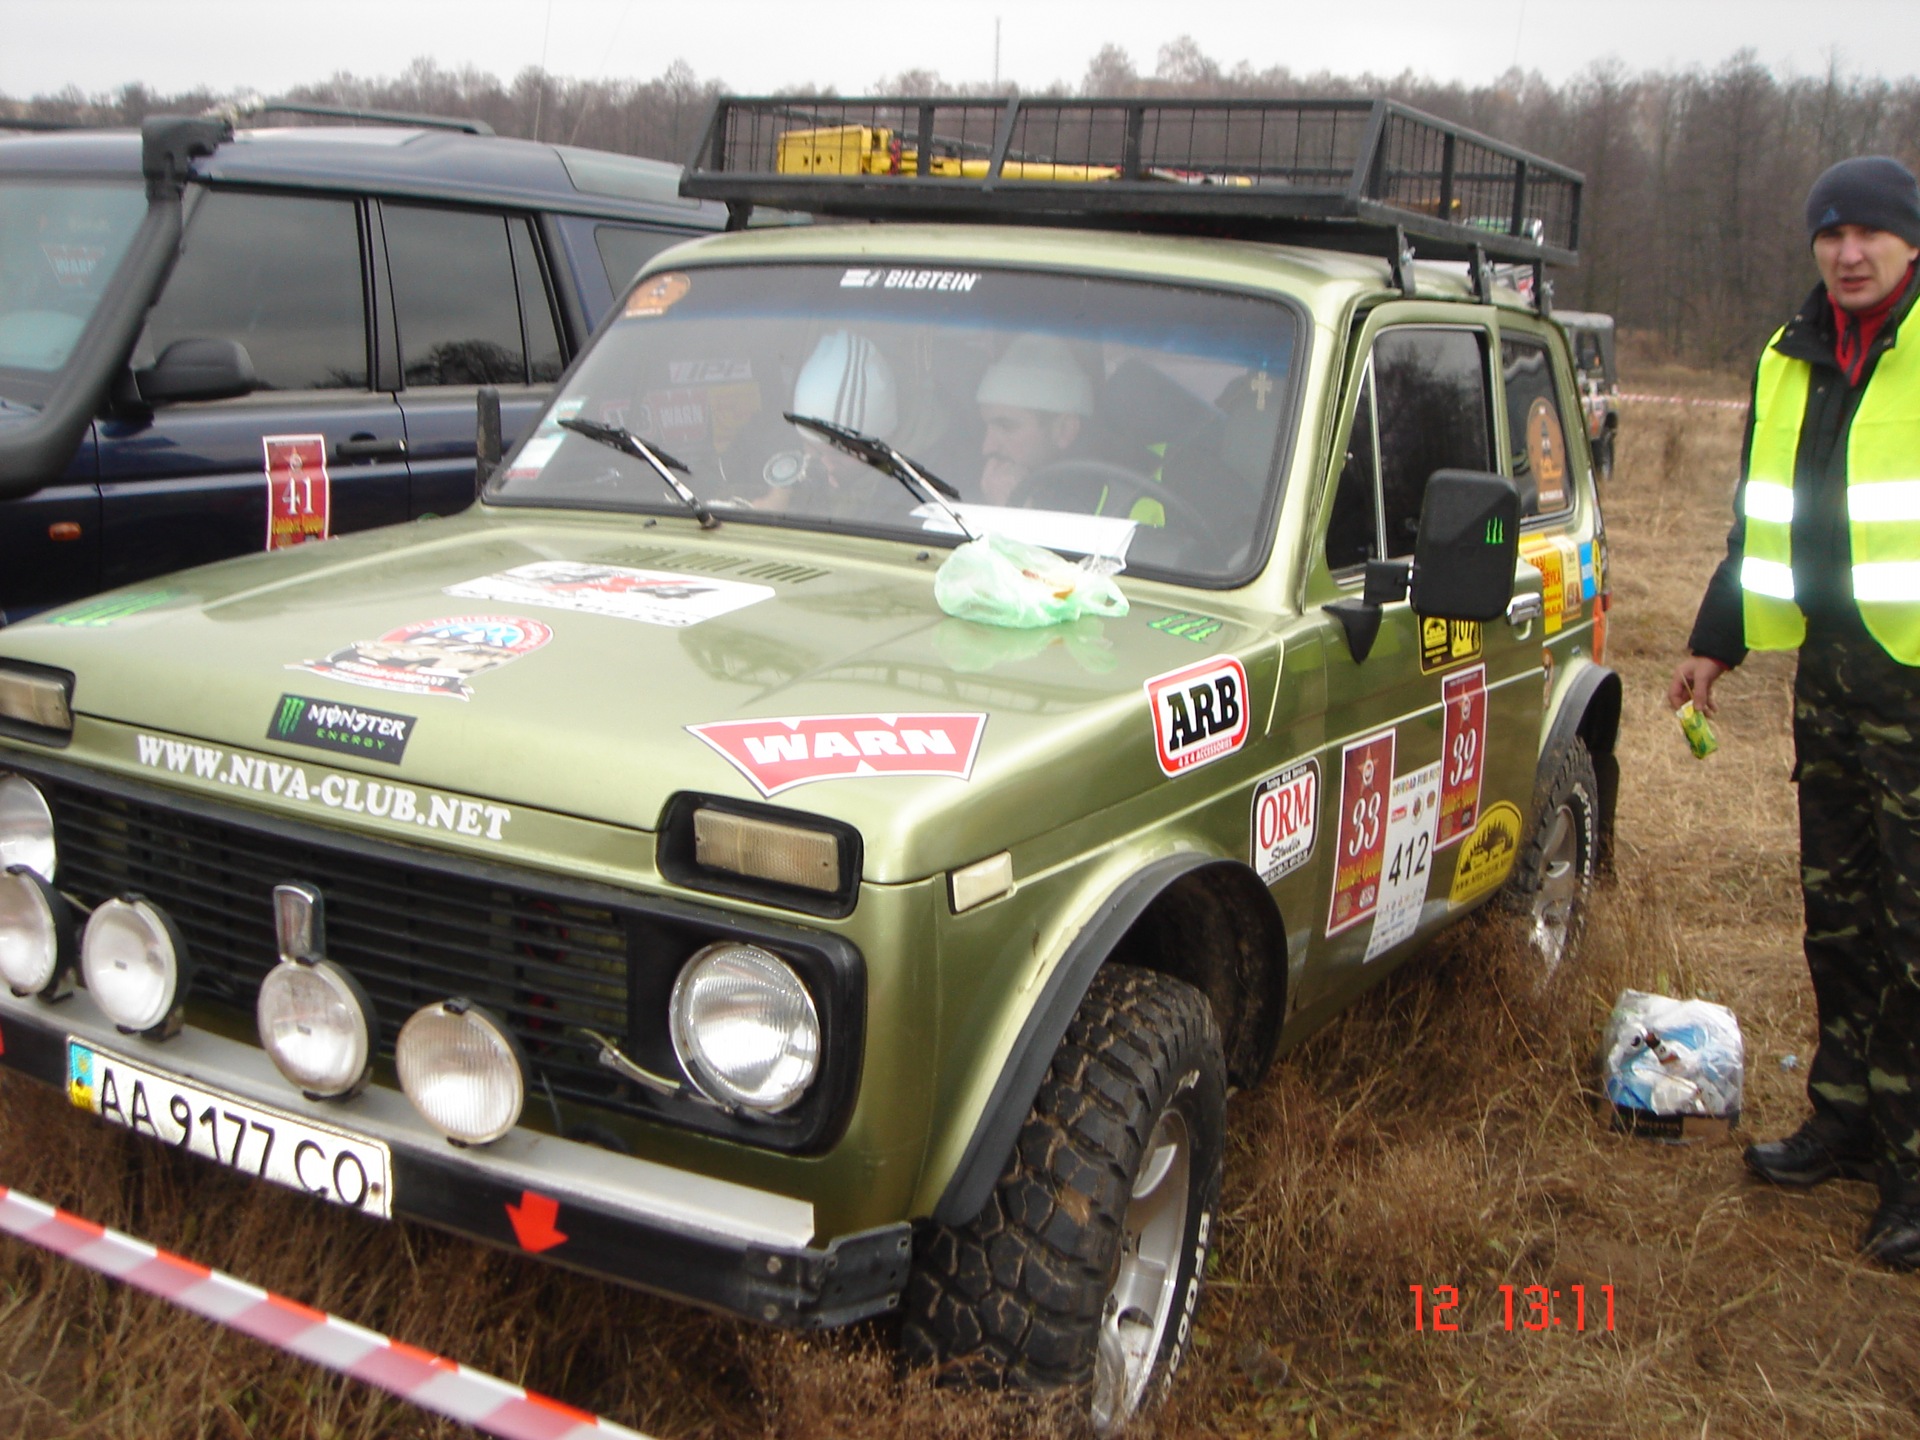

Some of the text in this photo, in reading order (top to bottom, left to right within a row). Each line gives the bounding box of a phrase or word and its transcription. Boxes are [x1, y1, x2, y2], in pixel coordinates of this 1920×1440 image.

[884, 269, 976, 291] BILSTEIN
[281, 477, 314, 515] 41
[306, 703, 407, 741] MONSTER
[315, 727, 387, 750] ENERGY
[1166, 675, 1240, 752] ARB
[742, 729, 976, 765] WARN
[1450, 728, 1477, 786] 32
[138, 733, 512, 840] WWW.NIVA-CLUB.NET
[1259, 777, 1313, 850] ORM
[1268, 838, 1301, 866] Studio
[1349, 792, 1381, 857] 33
[1388, 830, 1429, 887] 412
[101, 1067, 368, 1210] AA 9177 CO
